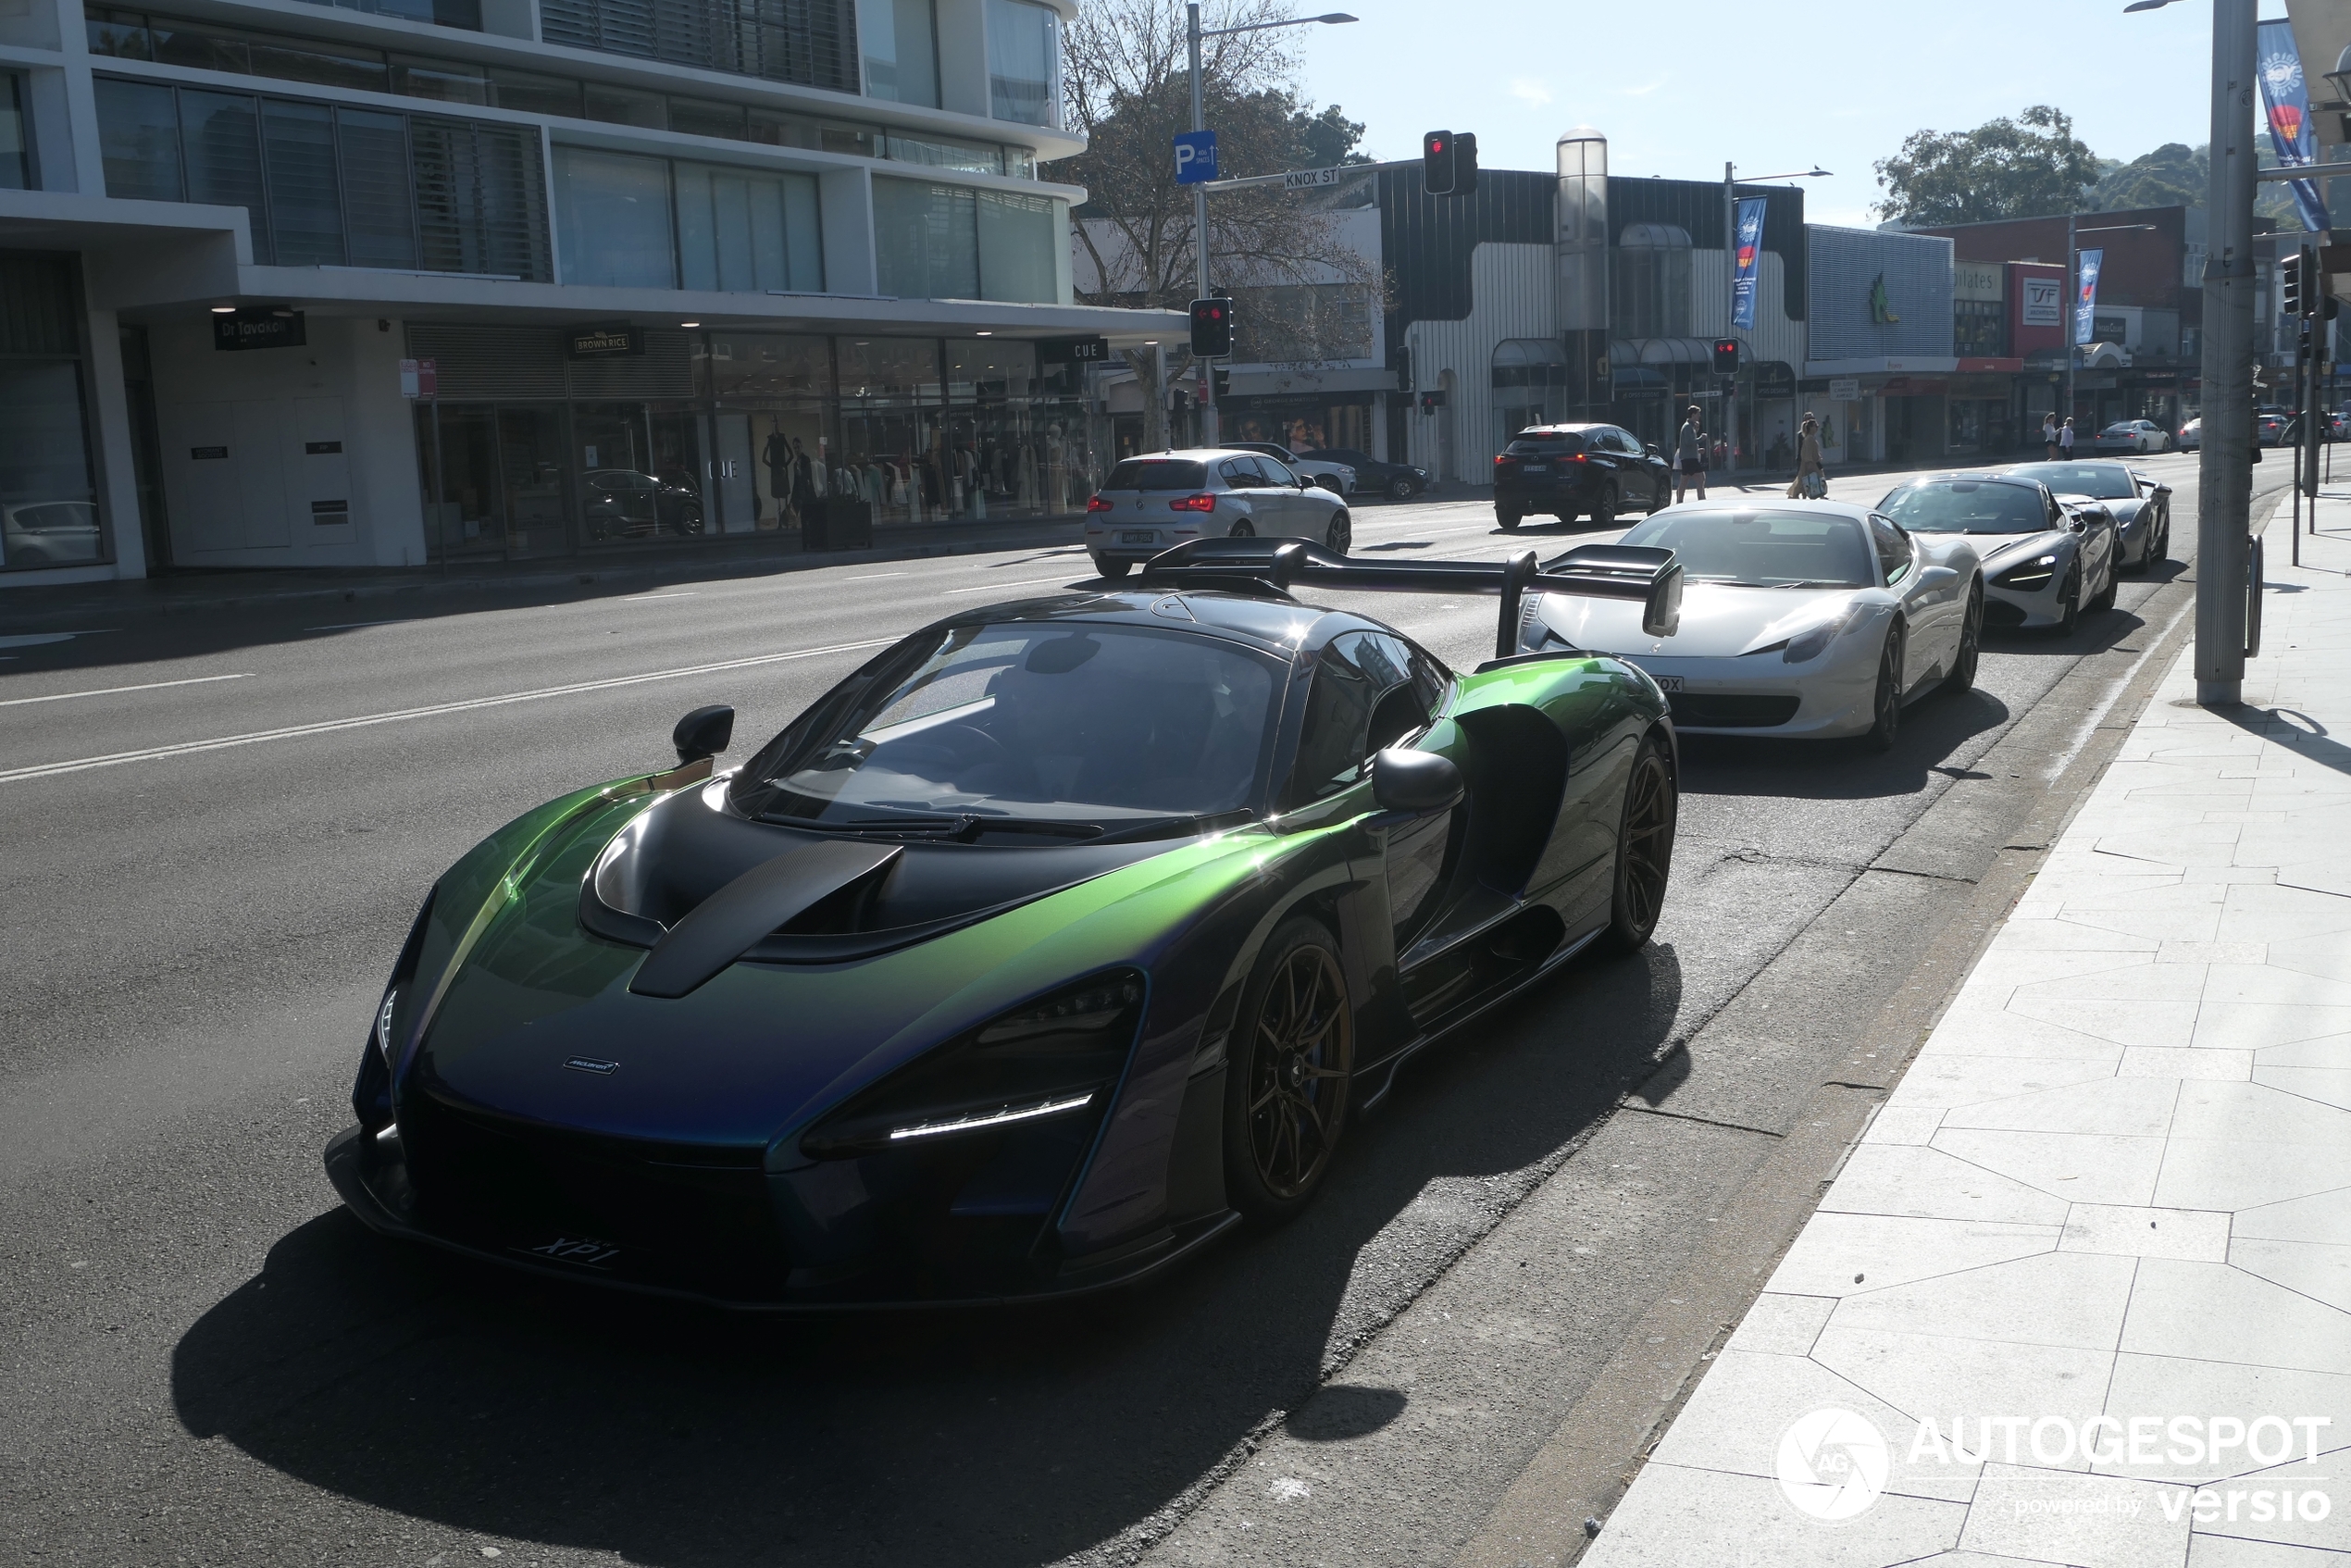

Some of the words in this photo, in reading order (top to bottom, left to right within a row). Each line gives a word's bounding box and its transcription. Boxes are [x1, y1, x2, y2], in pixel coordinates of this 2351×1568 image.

[1176, 144, 1195, 175] P
[1287, 172, 1317, 187] KNOX
[1323, 169, 1337, 182] ST
[1742, 224, 1757, 233] Yes
[222, 323, 235, 336] Dr
[578, 340, 607, 350] BROWN
[608, 338, 627, 347] RICE
[1075, 344, 1097, 357] CUE
[569, 1060, 608, 1070] McLaren
[532, 1237, 621, 1263] XP1
